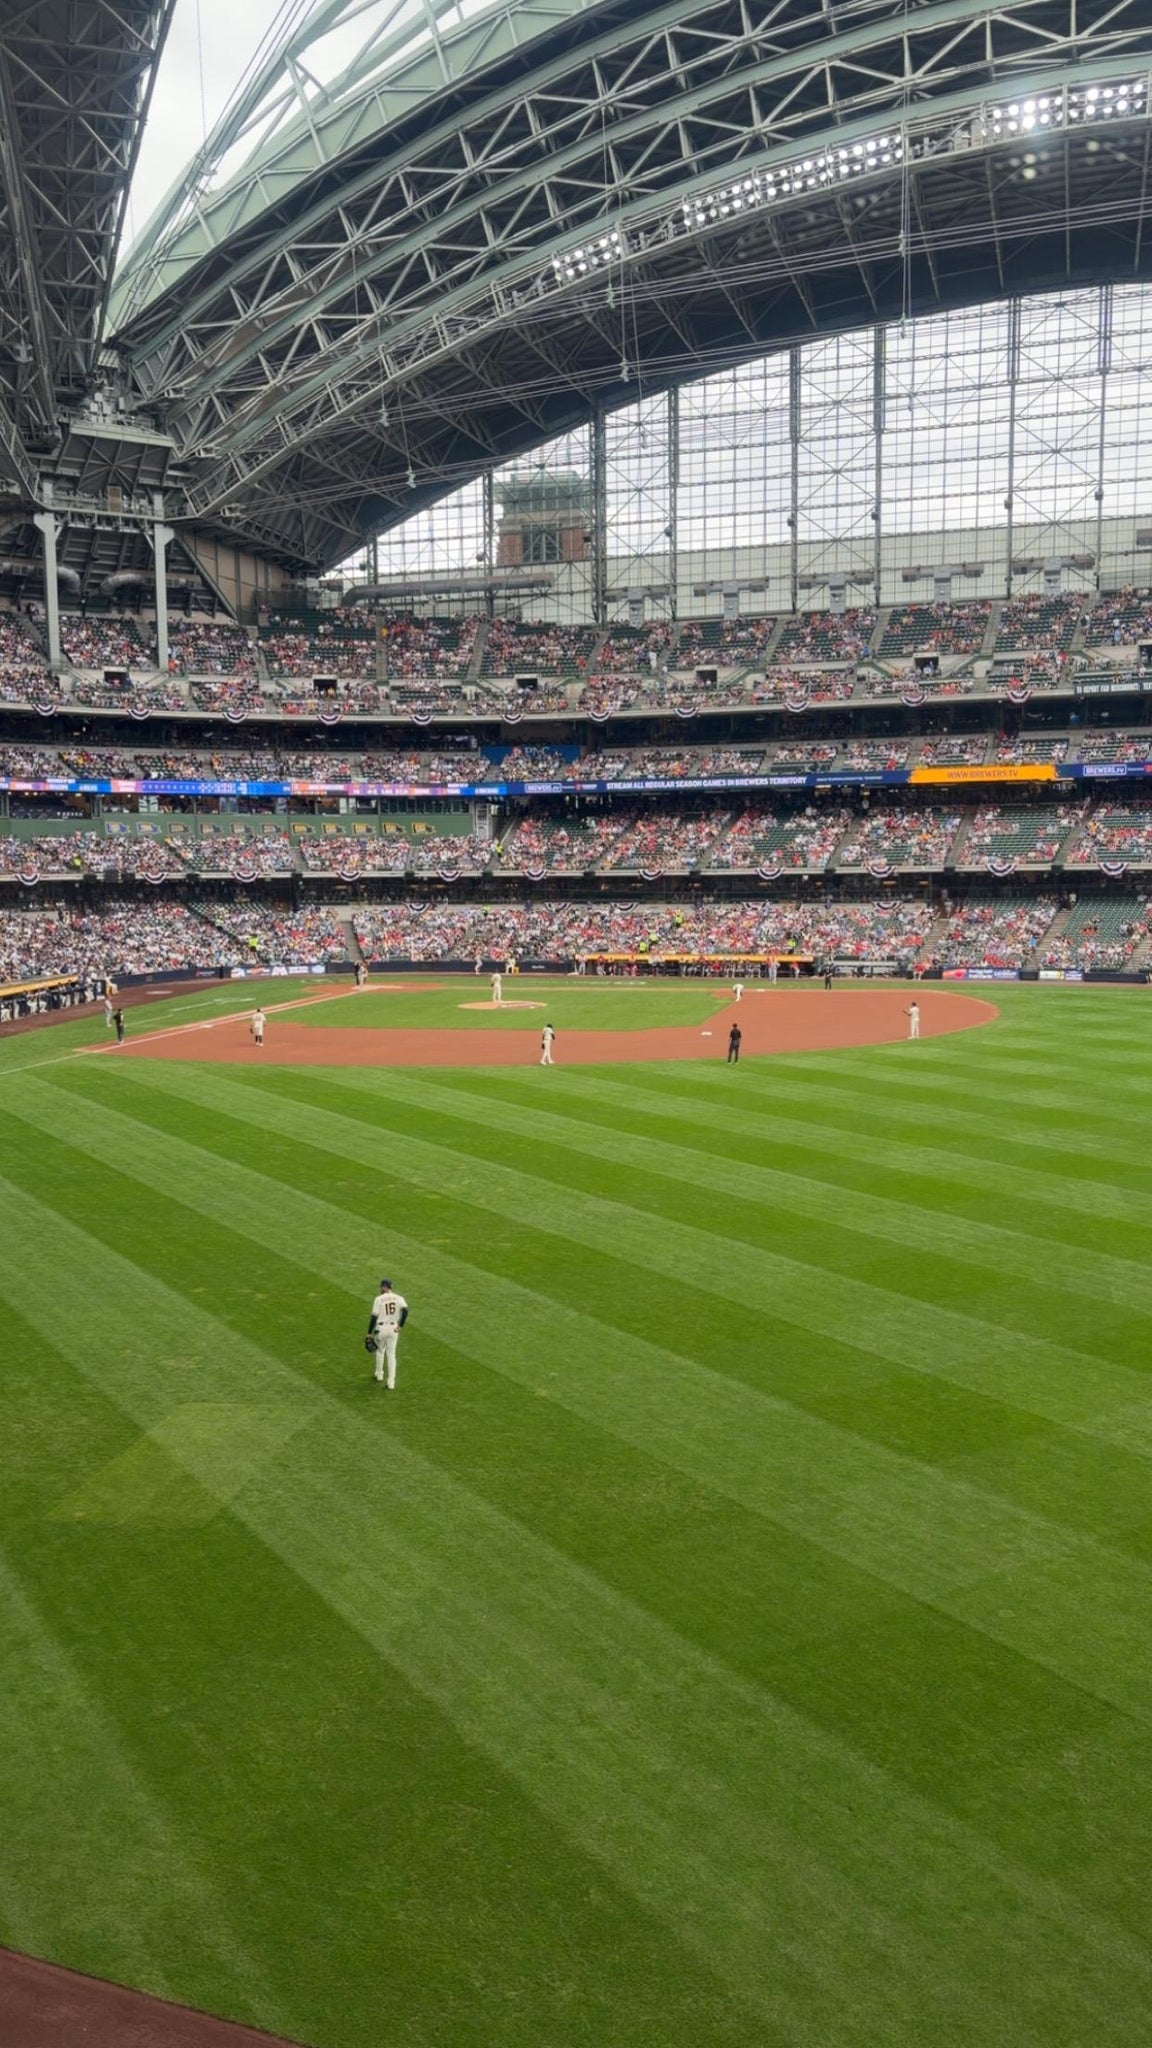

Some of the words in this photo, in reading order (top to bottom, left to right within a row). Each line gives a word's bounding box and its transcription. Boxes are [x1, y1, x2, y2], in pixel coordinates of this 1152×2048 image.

[703, 779, 726, 787] GAMES
[735, 778, 769, 786] BREWERS
[769, 776, 807, 784] TERRITORY
[385, 1302, 396, 1316] 16
